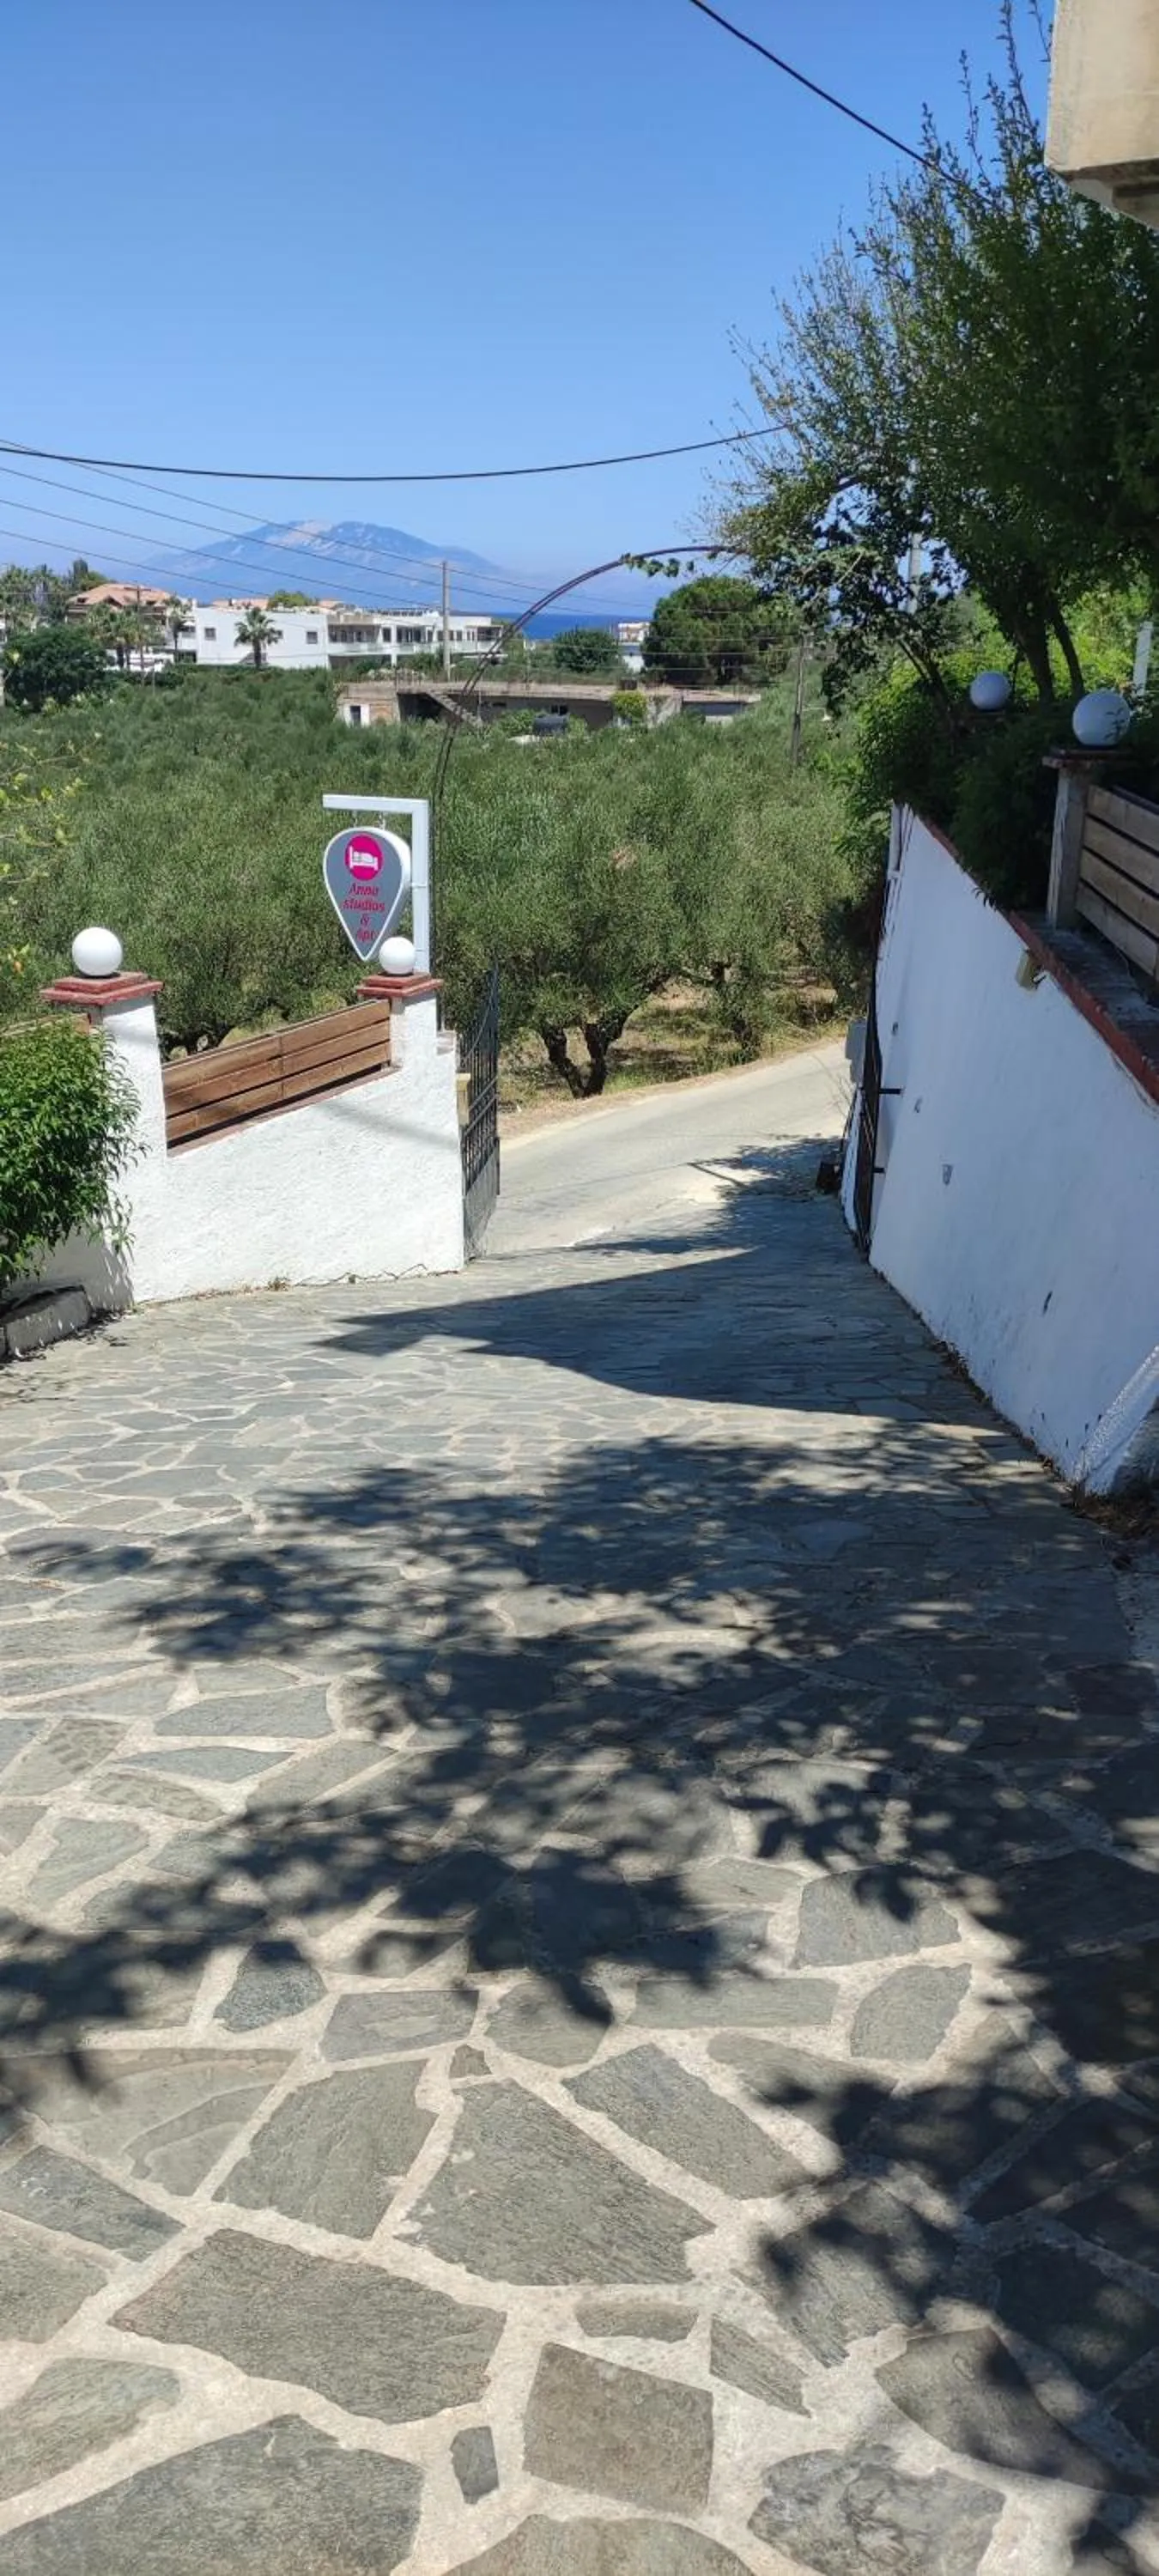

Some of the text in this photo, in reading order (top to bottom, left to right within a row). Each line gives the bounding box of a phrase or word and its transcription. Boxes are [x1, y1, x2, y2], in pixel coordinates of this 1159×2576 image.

[349, 882, 379, 896] Anna
[343, 898, 385, 912] studios
[360, 913, 370, 926] &
